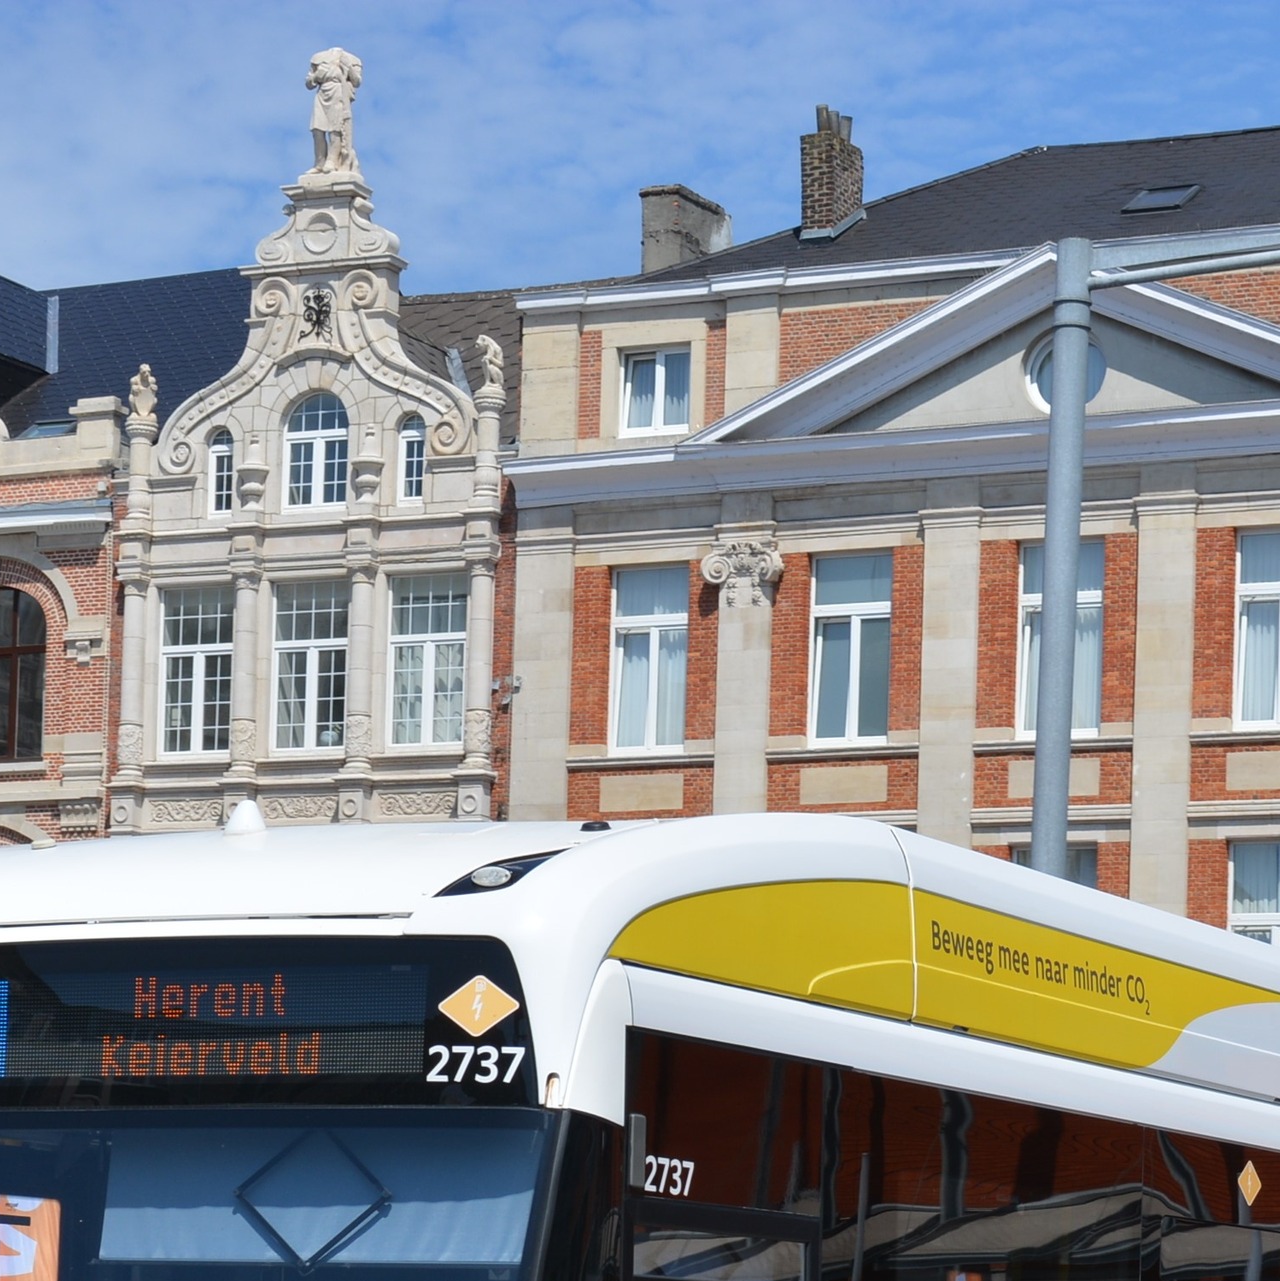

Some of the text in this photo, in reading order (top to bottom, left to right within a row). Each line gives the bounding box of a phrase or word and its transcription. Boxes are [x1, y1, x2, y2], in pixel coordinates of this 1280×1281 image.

[931, 920, 994, 975] Beweeg
[998, 945, 1029, 975] mee
[1035, 956, 1068, 985] naar
[1073, 961, 1122, 998] minder
[133, 973, 287, 1020] Herent
[100, 1032, 321, 1078] Keierveld
[426, 1044, 526, 1083] 2737
[644, 1154, 695, 1197] 2737
